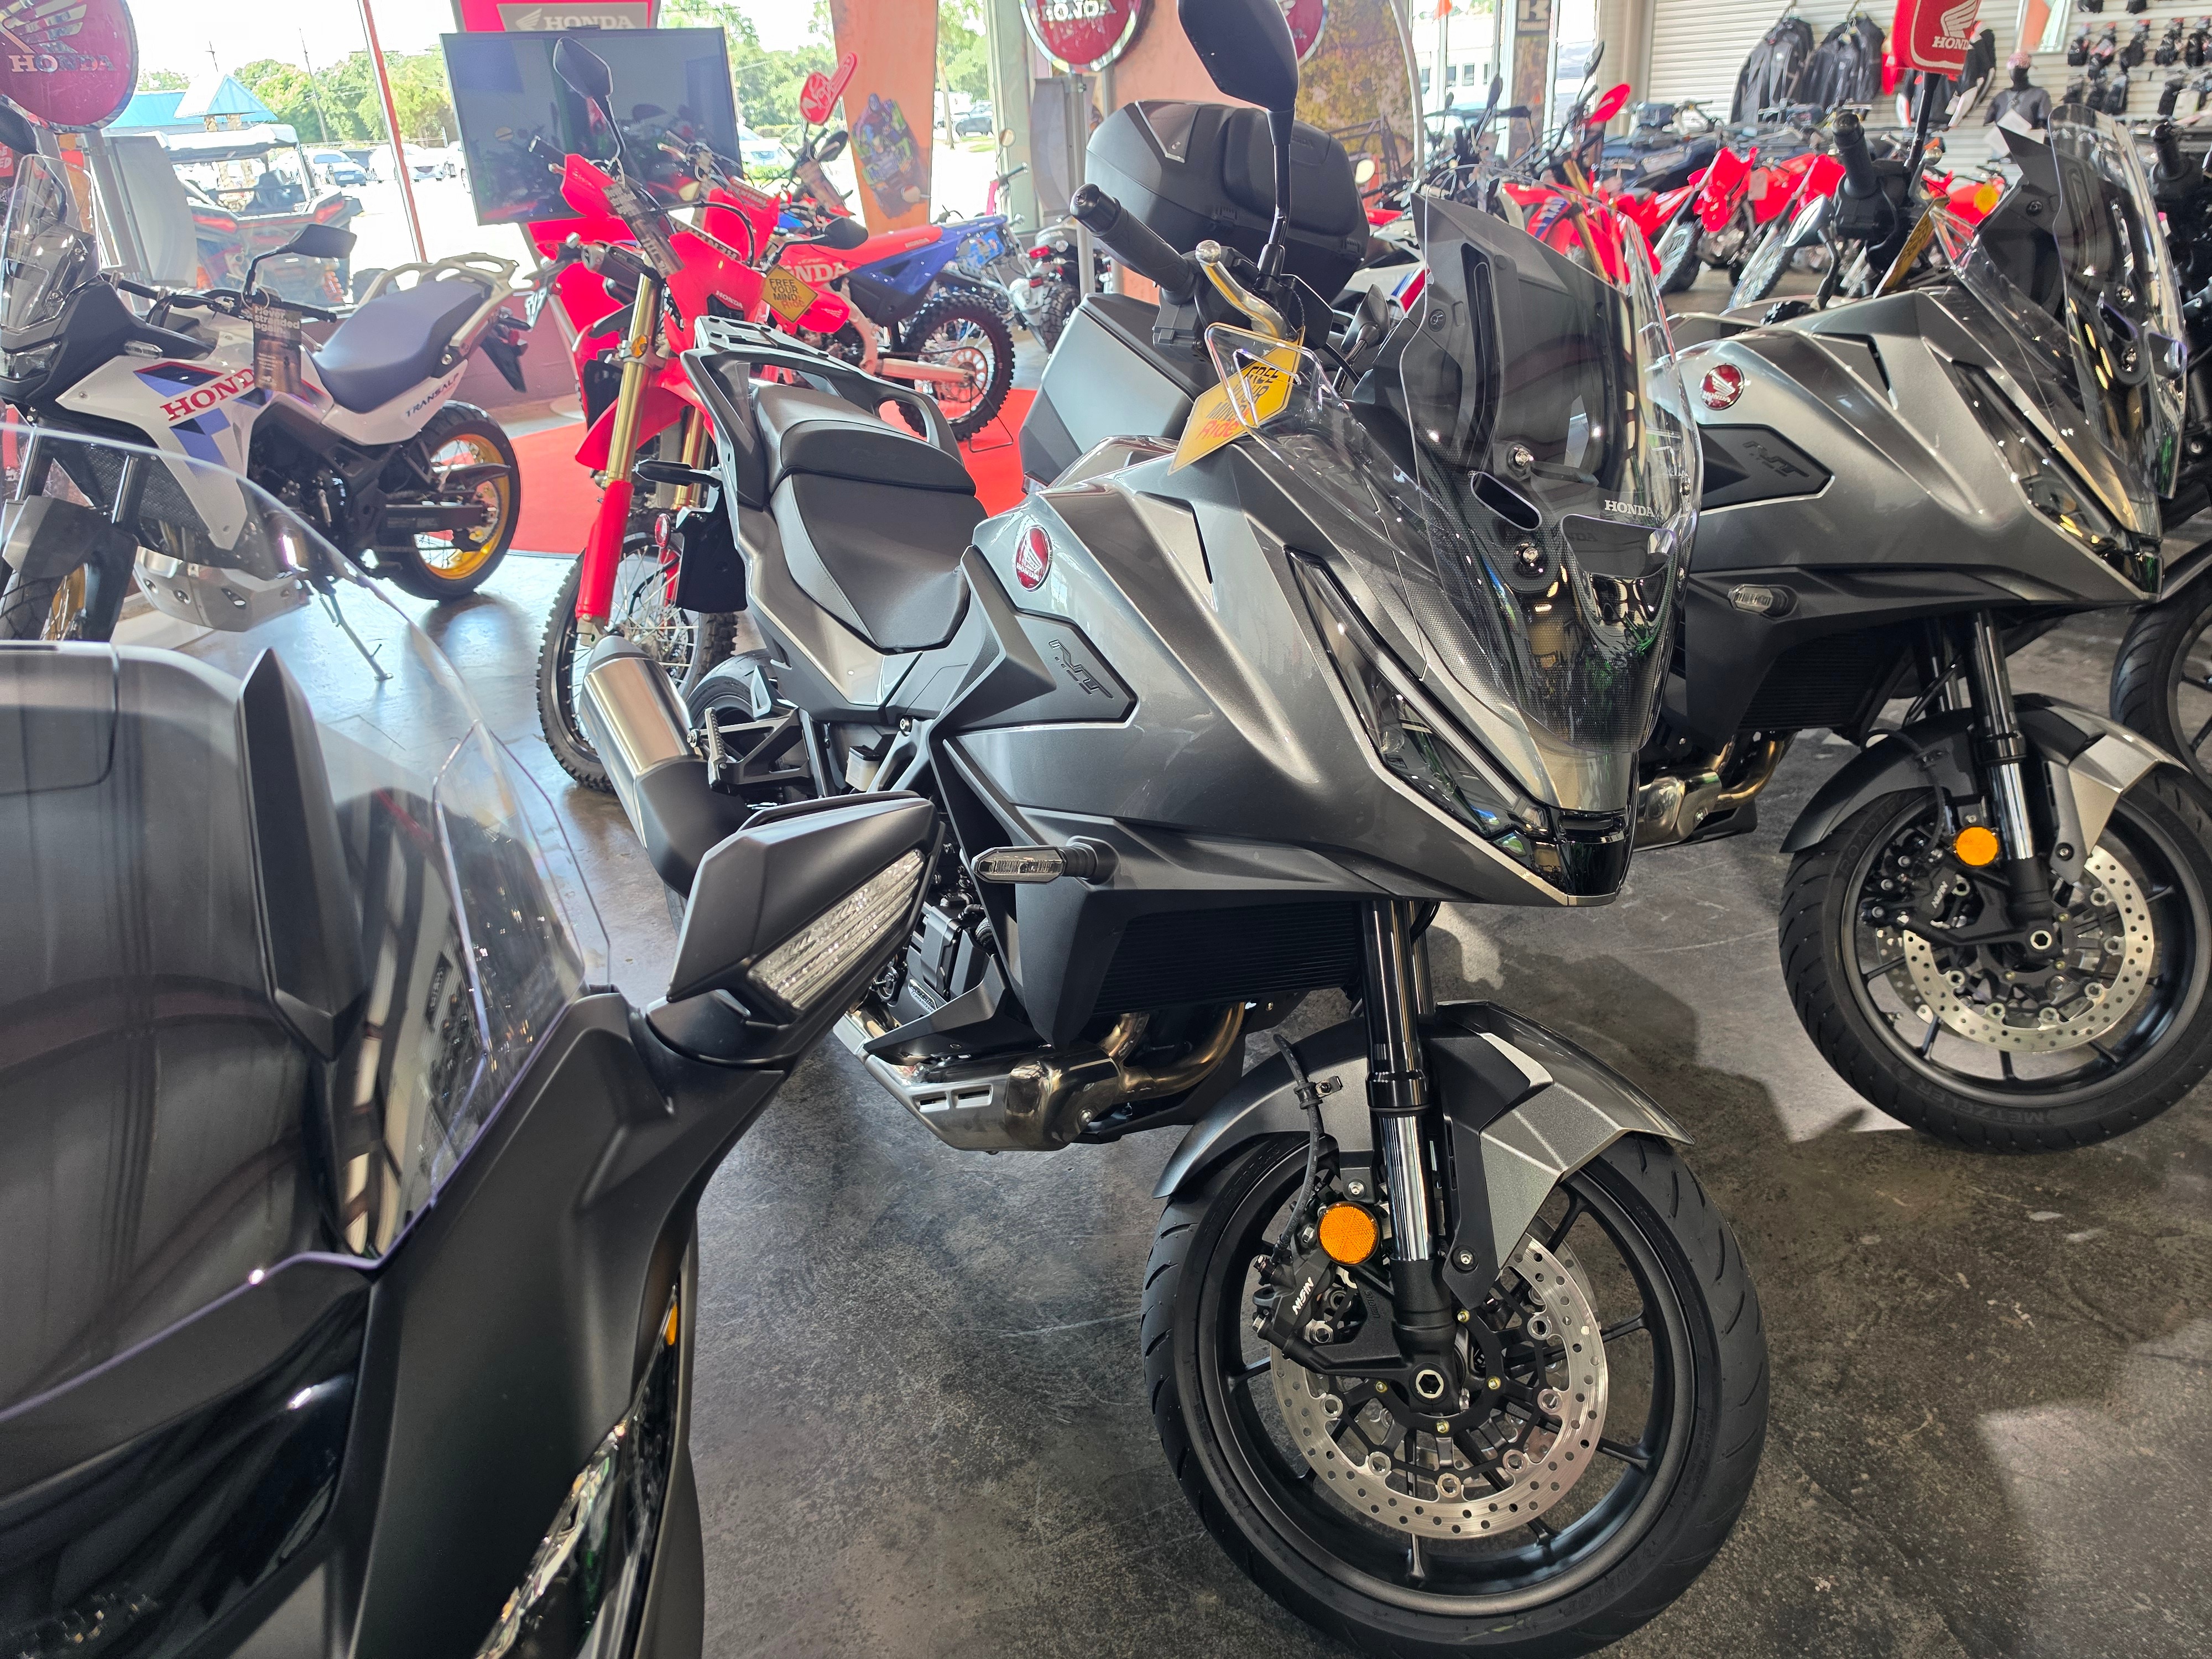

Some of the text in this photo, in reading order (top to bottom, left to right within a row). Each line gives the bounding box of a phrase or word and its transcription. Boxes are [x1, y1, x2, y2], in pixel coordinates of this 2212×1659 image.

[544, 15, 636, 31] HONDA
[1932, 36, 1969, 50] HOND
[8, 54, 117, 72] HONDA
[793, 262, 851, 283] NDA
[769, 278, 795, 287] FREE
[773, 285, 799, 294] YOUR
[254, 306, 286, 319] Never
[254, 315, 300, 329] stranded
[1243, 366, 1279, 384] FREE
[160, 368, 254, 421] HOND
[406, 373, 460, 417] TRANSALP
[1196, 418, 1239, 440] Ride
[1604, 499, 1656, 518] HONDA
[911, 989, 935, 1013] Transmissio
[1292, 1276, 1314, 1316] NISSIN
